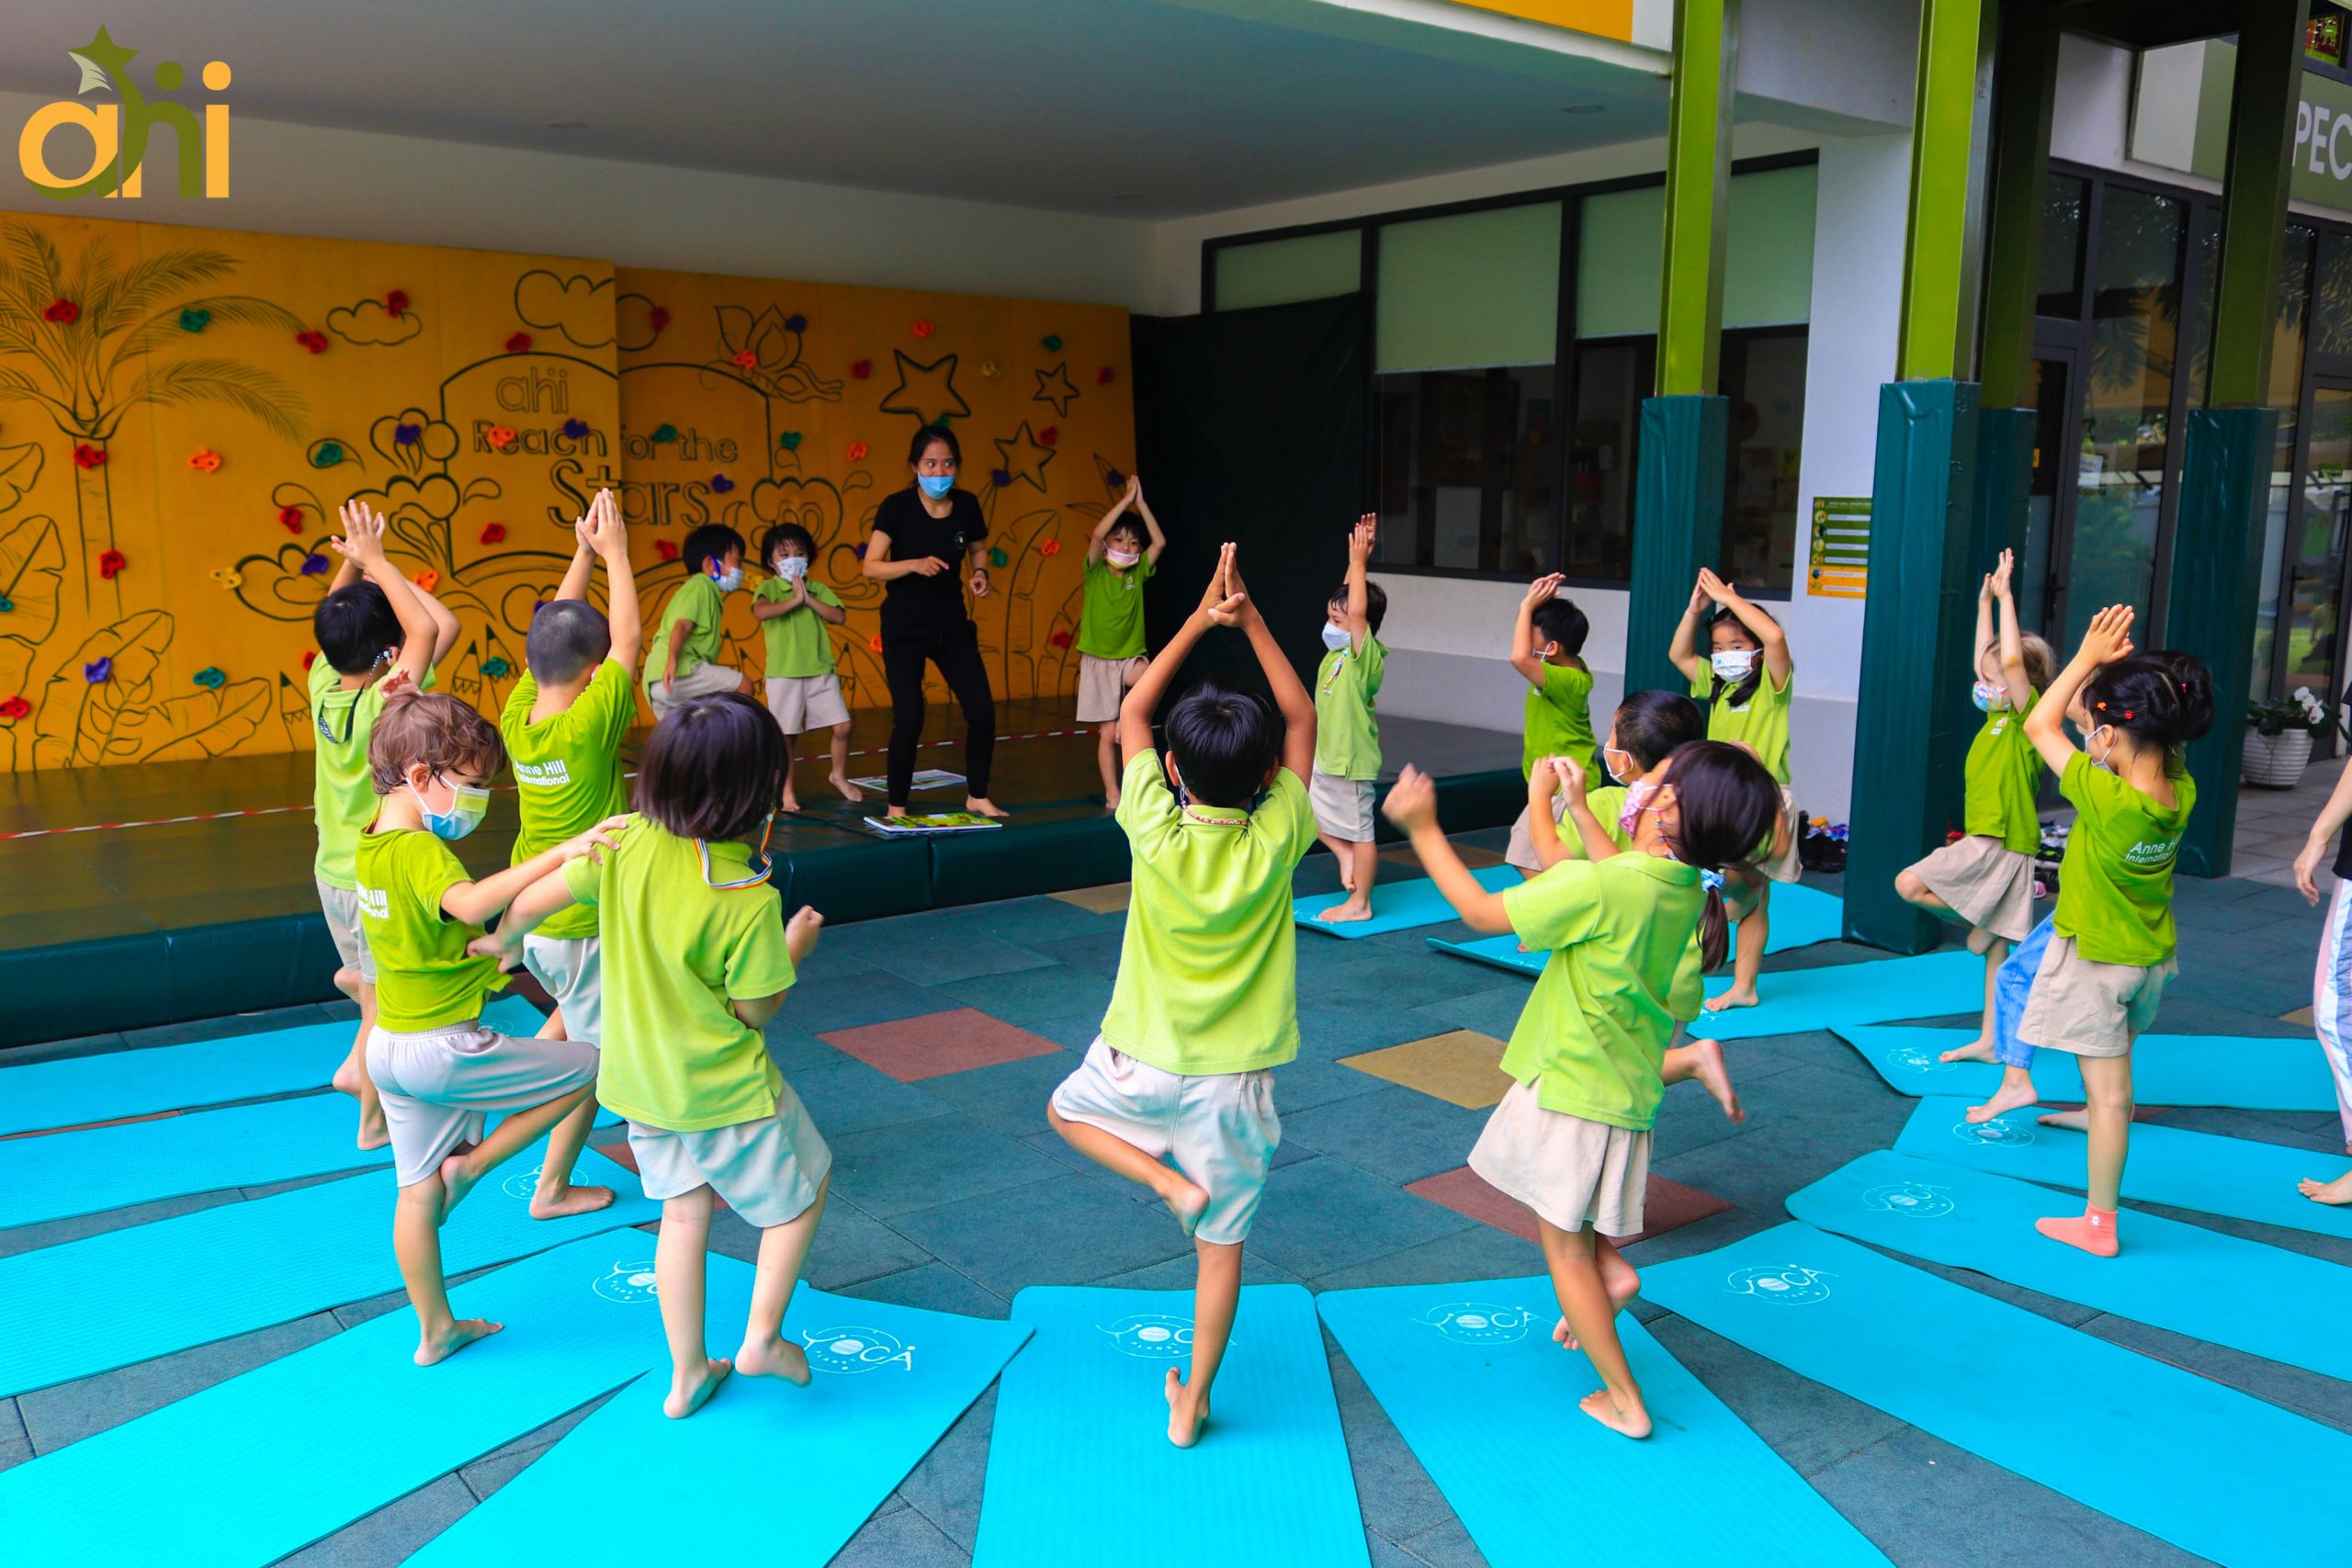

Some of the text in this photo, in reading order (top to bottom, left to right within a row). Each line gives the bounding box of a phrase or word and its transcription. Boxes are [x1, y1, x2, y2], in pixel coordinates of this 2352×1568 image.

[496, 367, 569, 413] ahi
[678, 427, 739, 463] the
[542, 759, 566, 775] Hill
[2130, 840, 2165, 854] Anne
